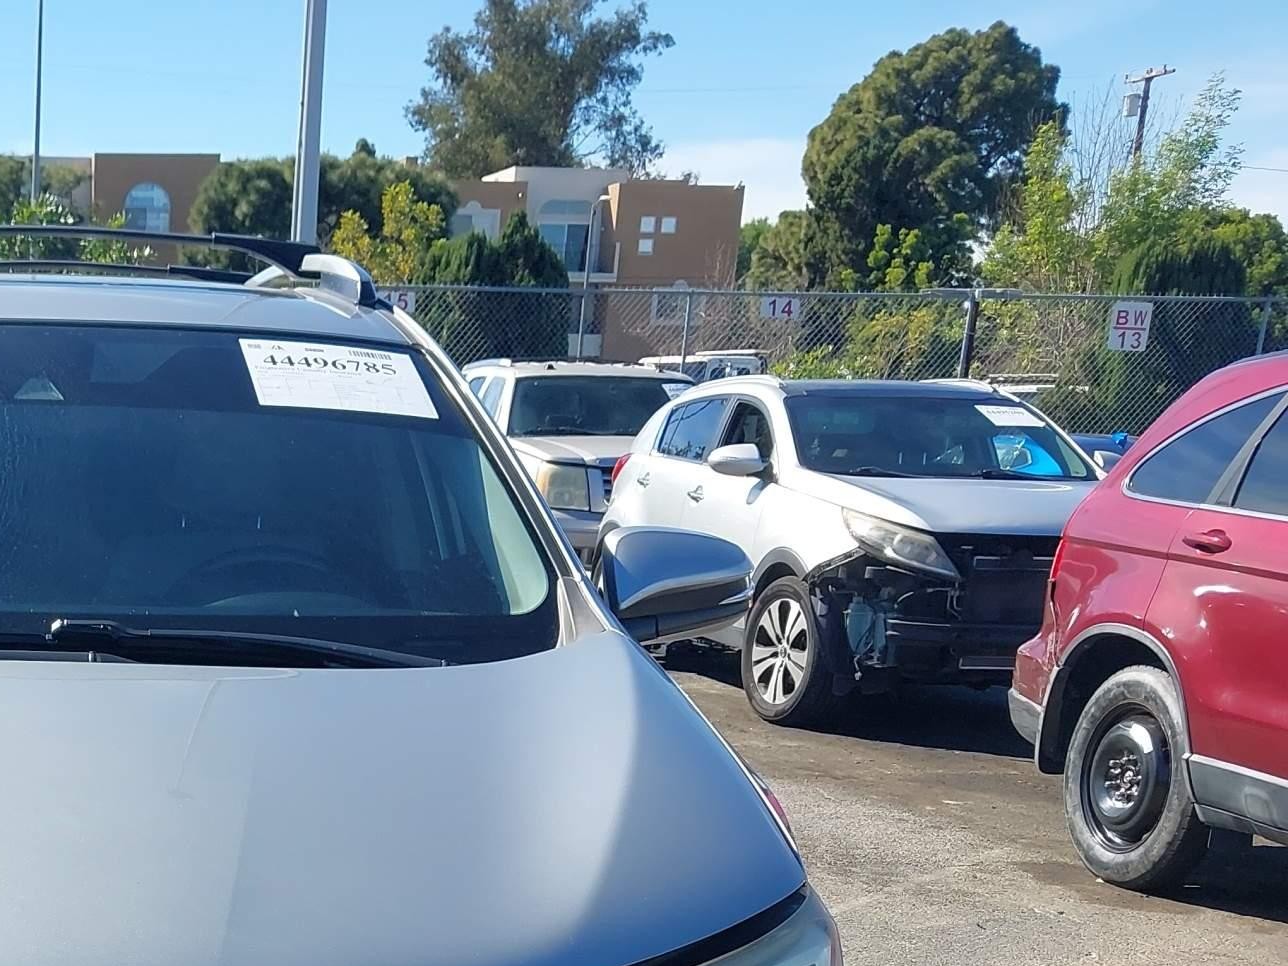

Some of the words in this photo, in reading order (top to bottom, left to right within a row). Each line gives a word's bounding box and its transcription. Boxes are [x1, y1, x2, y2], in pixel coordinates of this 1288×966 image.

[768, 299, 793, 317] 14
[1117, 331, 1141, 349] 13
[263, 354, 397, 376] 44496785
